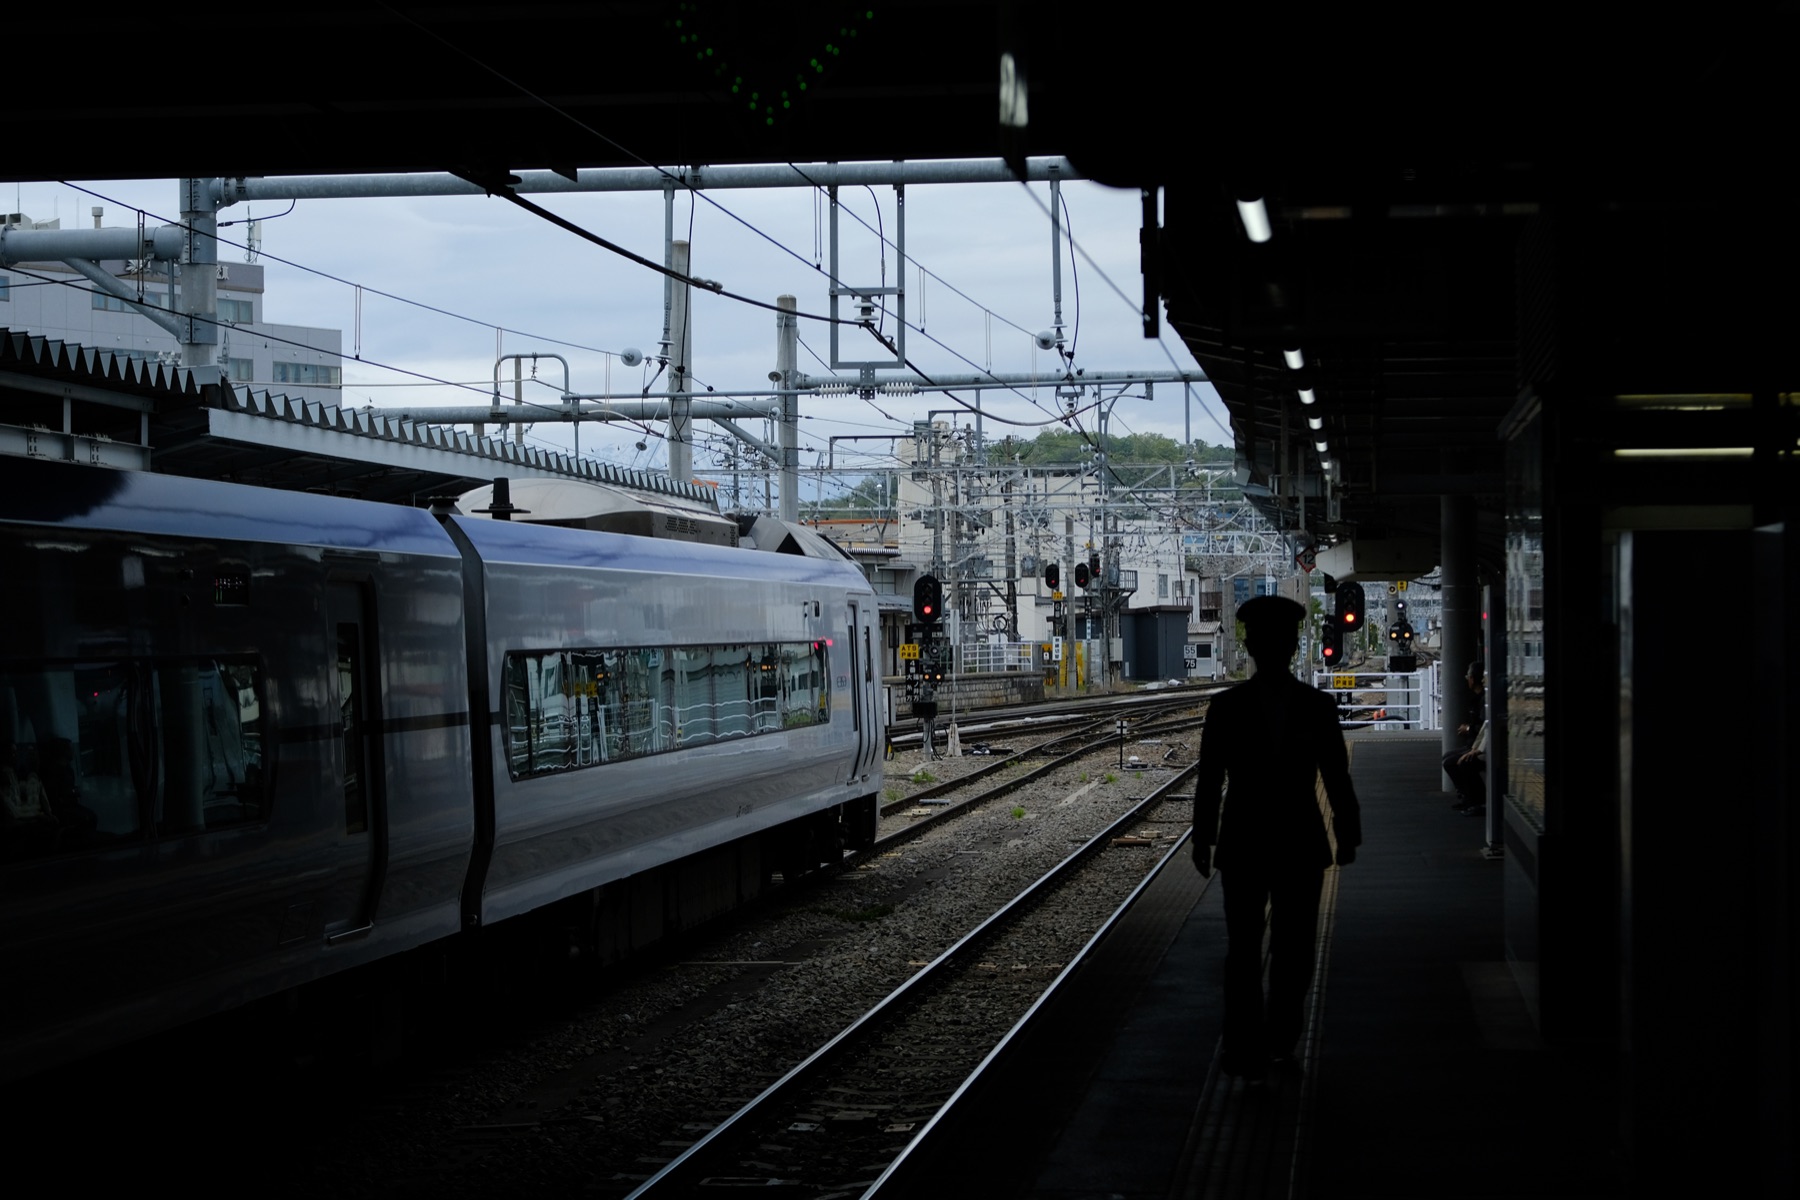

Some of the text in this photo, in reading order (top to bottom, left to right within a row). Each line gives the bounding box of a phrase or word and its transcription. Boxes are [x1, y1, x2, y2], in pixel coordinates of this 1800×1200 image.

[1303, 554, 1315, 564] 12
[1185, 646, 1195, 655] 55
[1185, 659, 1196, 668] 75
